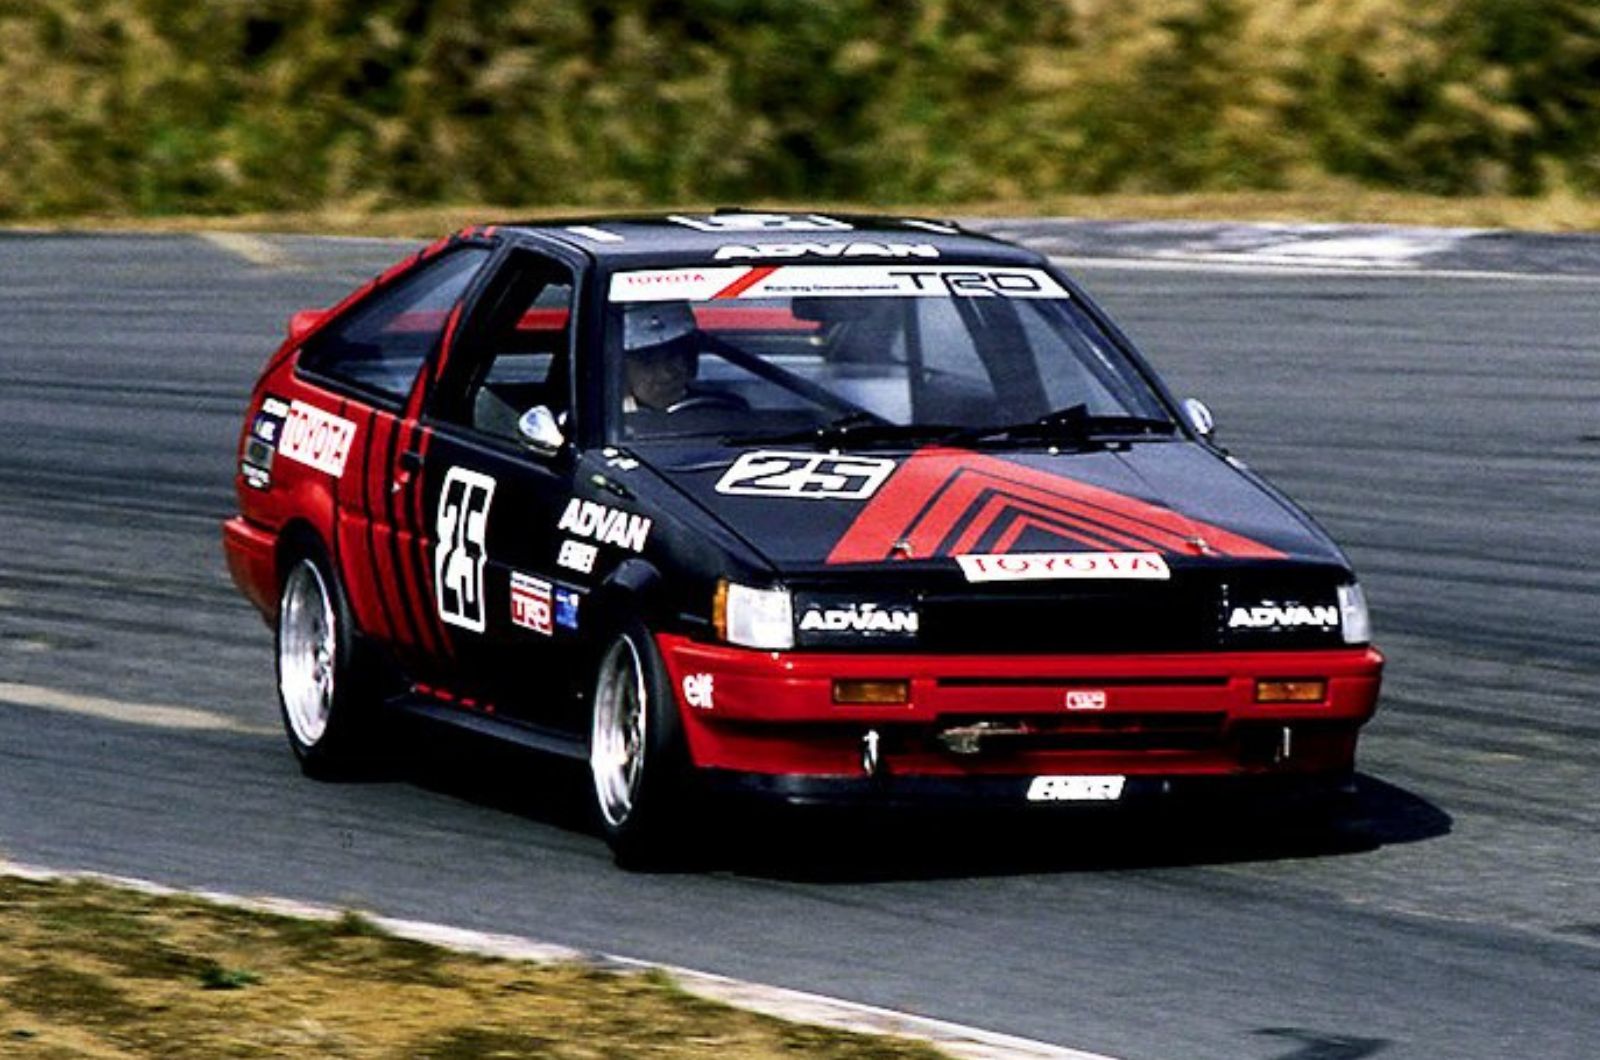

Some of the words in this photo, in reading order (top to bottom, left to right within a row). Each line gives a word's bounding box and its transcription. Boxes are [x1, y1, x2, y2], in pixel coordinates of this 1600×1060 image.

[713, 243, 939, 260] ADVAN
[626, 274, 705, 285] TOYOTA
[889, 271, 1043, 297] TRD
[283, 406, 350, 469] TOYOTA
[728, 456, 873, 493] 25
[557, 498, 651, 553] ADVAN
[440, 476, 489, 622] 25
[973, 556, 1161, 574] TOYOTA
[800, 608, 919, 632] ADVAN
[1228, 606, 1338, 628] ADVAN
[682, 673, 714, 709] elf
